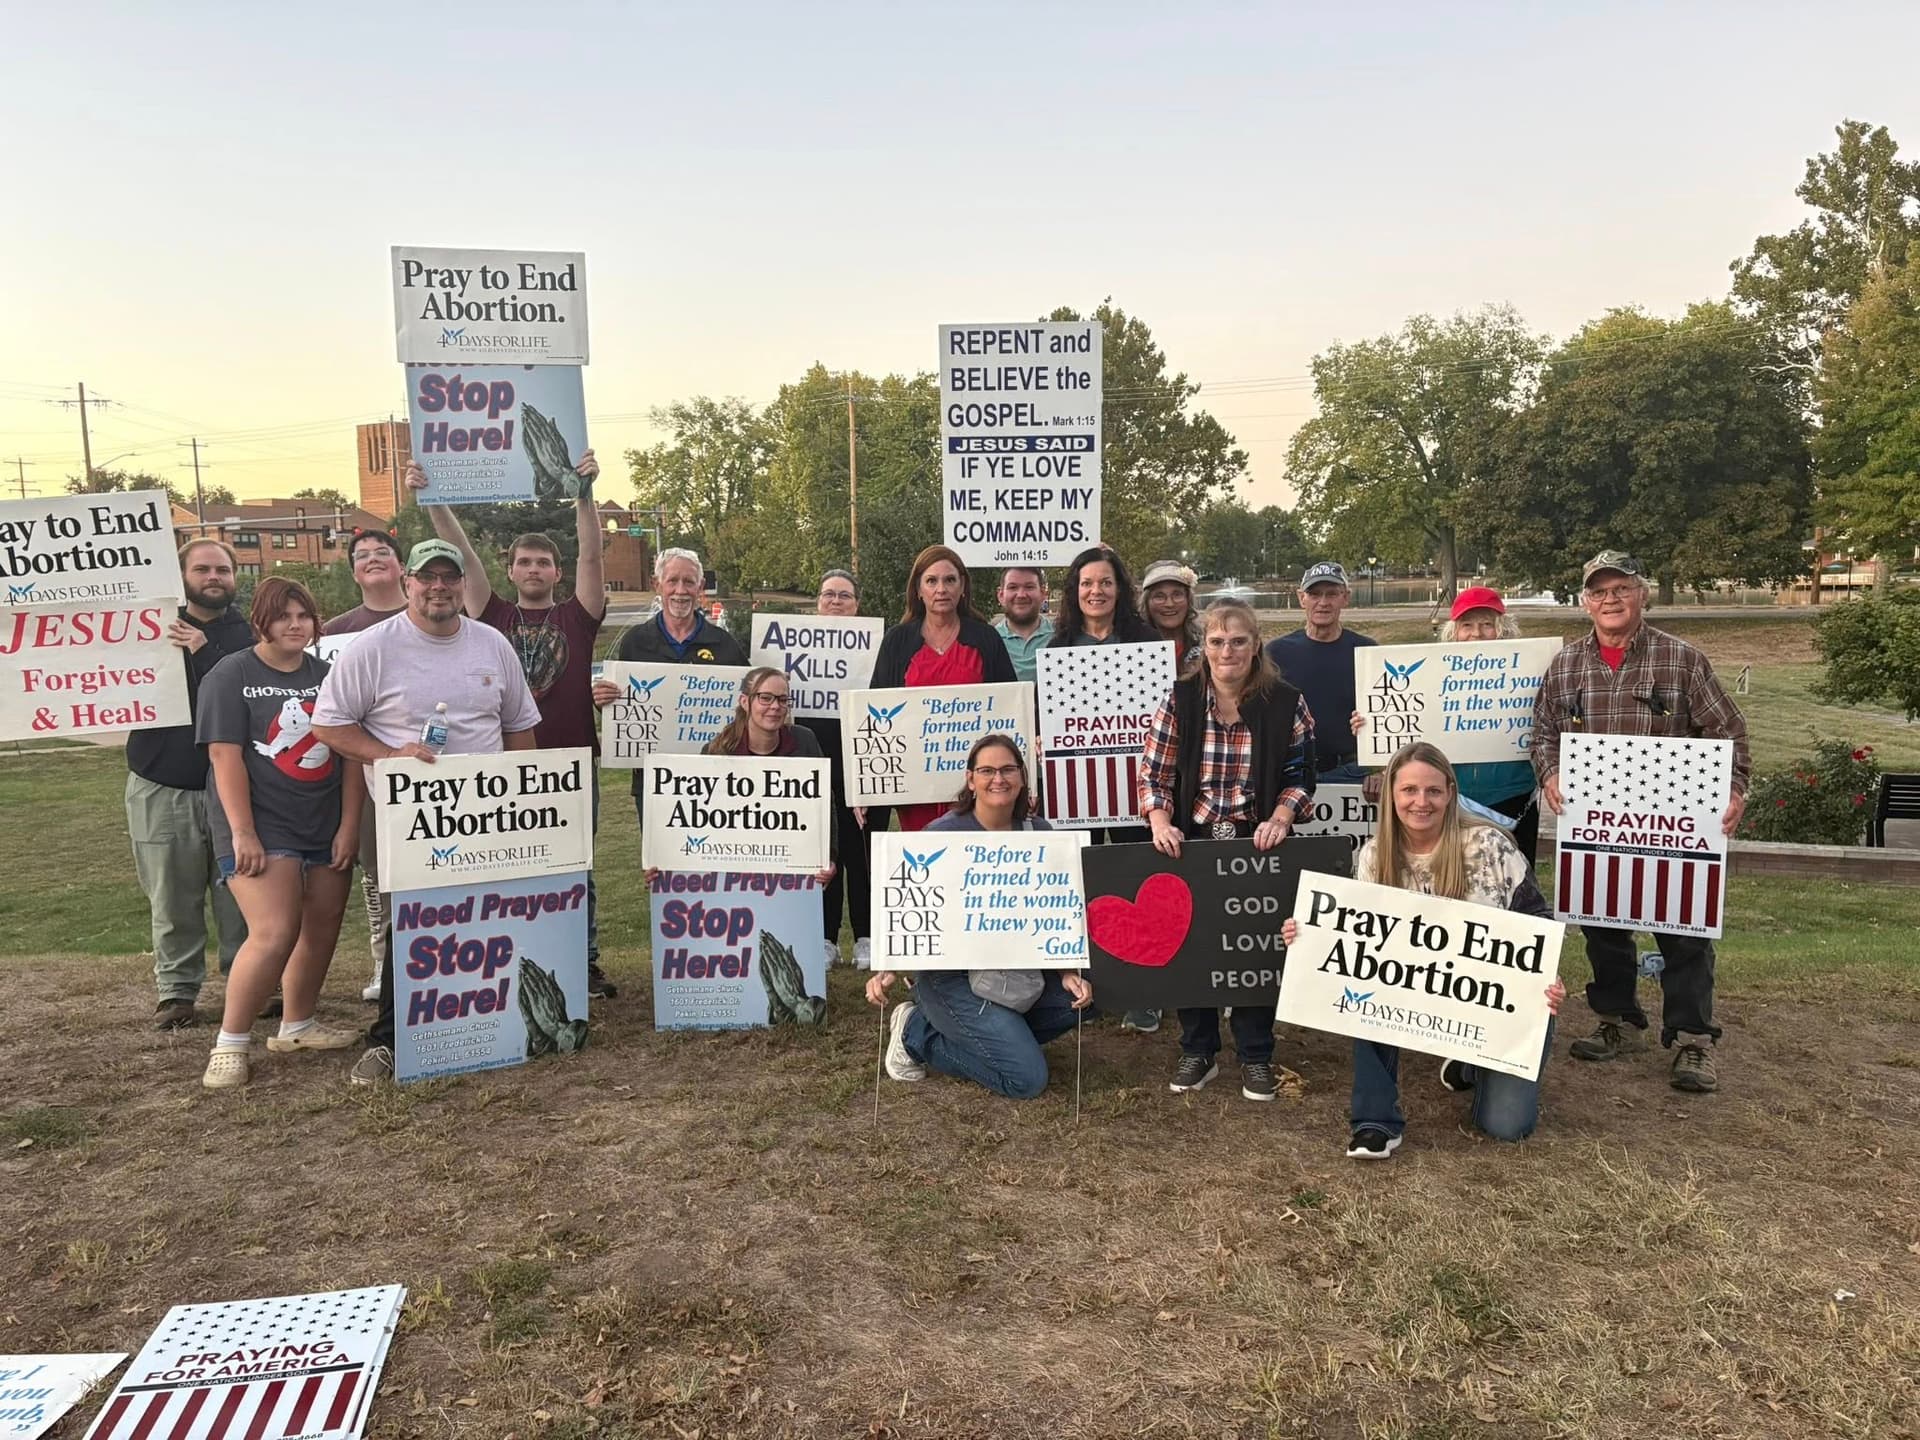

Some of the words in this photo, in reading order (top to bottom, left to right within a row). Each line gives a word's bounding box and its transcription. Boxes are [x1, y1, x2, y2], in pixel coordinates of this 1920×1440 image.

[401, 260, 473, 298] Pray
[479, 265, 509, 290] to
[517, 263, 578, 292] End
[419, 291, 565, 323] Abortion.
[950, 329, 1044, 355] REPENT
[1050, 329, 1091, 353] and
[951, 366, 1049, 391] BELIEVE
[1056, 366, 1091, 390] the
[417, 373, 514, 420] Stop
[948, 403, 1049, 427] GOSPEL.
[1052, 416, 1074, 426] Mark
[1078, 415, 1095, 425] 1:15
[422, 420, 514, 453] Here!
[956, 438, 1028, 451] JESUS
[1035, 437, 1088, 450] SAID
[961, 457, 979, 478] IF
[986, 456, 1014, 478] YE
[1022, 455, 1081, 478] LOVE
[950, 489, 987, 514] ME,
[995, 488, 1053, 510] KEEP
[1061, 488, 1094, 510] MY
[44, 513, 81, 539] to
[88, 502, 162, 536] End
[953, 520, 1090, 543] COMMANDS.
[994, 551, 1019, 561] John
[1022, 550, 1048, 561] 14:15
[0, 608, 162, 655] JESUS
[760, 621, 871, 650] ABORTION
[785, 653, 847, 681] KILLS
[1512, 653, 1520, 669] I
[21, 664, 156, 695] Forgives
[1439, 673, 1505, 696] formed
[1510, 675, 1542, 693] you
[243, 685, 320, 698] GHOSTBUST
[675, 693, 732, 711] formed
[1368, 692, 1424, 713] DAYS
[1443, 696, 1459, 711] in
[1466, 694, 1493, 710] the
[612, 704, 662, 721] DAYS
[987, 696, 994, 711] I
[31, 707, 59, 731] &
[71, 700, 156, 728] Heals
[678, 711, 695, 724] in
[698, 710, 721, 724] the
[919, 715, 982, 739] formed
[986, 717, 1015, 733] you
[1065, 714, 1152, 732] PRAYING
[1373, 714, 1424, 734] FOR
[1443, 714, 1451, 731] I
[1456, 713, 1502, 731] knew
[616, 723, 660, 741] FOR
[677, 727, 685, 741] I
[1053, 735, 1085, 748] FOR
[1090, 732, 1148, 746] AMERI
[852, 735, 906, 755] DAYS
[923, 739, 939, 753] in
[945, 737, 969, 753] the
[858, 756, 907, 776] FOR
[925, 757, 932, 772] I
[386, 773, 467, 811] Pray
[474, 771, 508, 799] to
[517, 760, 583, 796] End
[652, 767, 720, 805] Pray
[725, 771, 754, 798] to
[762, 769, 821, 799] End
[405, 801, 568, 841] Abortion.
[666, 799, 807, 831] Abortion.
[1587, 810, 1695, 833] PRAYING
[1572, 827, 1610, 843] FOR
[1616, 831, 1710, 850] AMERICA
[964, 845, 1032, 869] “Before
[1037, 846, 1045, 862] I
[1612, 845, 1640, 855] NATION
[1641, 848, 1666, 856] UNDER
[1667, 850, 1683, 858] GOD
[889, 860, 930, 888] 40
[1216, 856, 1281, 875] LOVE
[652, 871, 718, 893] Need
[960, 867, 1031, 891] formed
[1036, 871, 1069, 890] you
[396, 896, 475, 931] Need
[480, 883, 586, 921] Prayer?
[883, 886, 945, 908] DAYS
[964, 892, 982, 909] in
[989, 889, 1018, 908] the
[1023, 890, 1083, 911] womb,
[1224, 896, 1279, 915] GOD
[660, 899, 754, 947] Stop
[889, 910, 944, 933] FOR
[964, 913, 973, 931] I
[978, 912, 1027, 931] knew
[1032, 912, 1082, 935] you.”
[1304, 889, 1400, 952] Pray
[1410, 914, 1449, 951] to
[1458, 920, 1546, 974] End
[1643, 920, 1660, 928] CALL
[1037, 936, 1084, 955] -God
[1222, 933, 1285, 951] LOVE
[406, 932, 514, 980] Stop
[662, 947, 752, 980] Here!
[1317, 937, 1516, 1014] Abortion.
[407, 977, 510, 1027] Here!
[469, 1019, 499, 1032] Church
[440, 1036, 482, 1050] Frederick
[175, 1341, 335, 1367] PRAYING
[144, 1368, 206, 1383] FOR
[212, 1353, 349, 1377] AMERICA
[177, 1380, 200, 1388] ONE
[203, 1376, 244, 1385] NATION
[247, 1373, 283, 1381] UNDER
